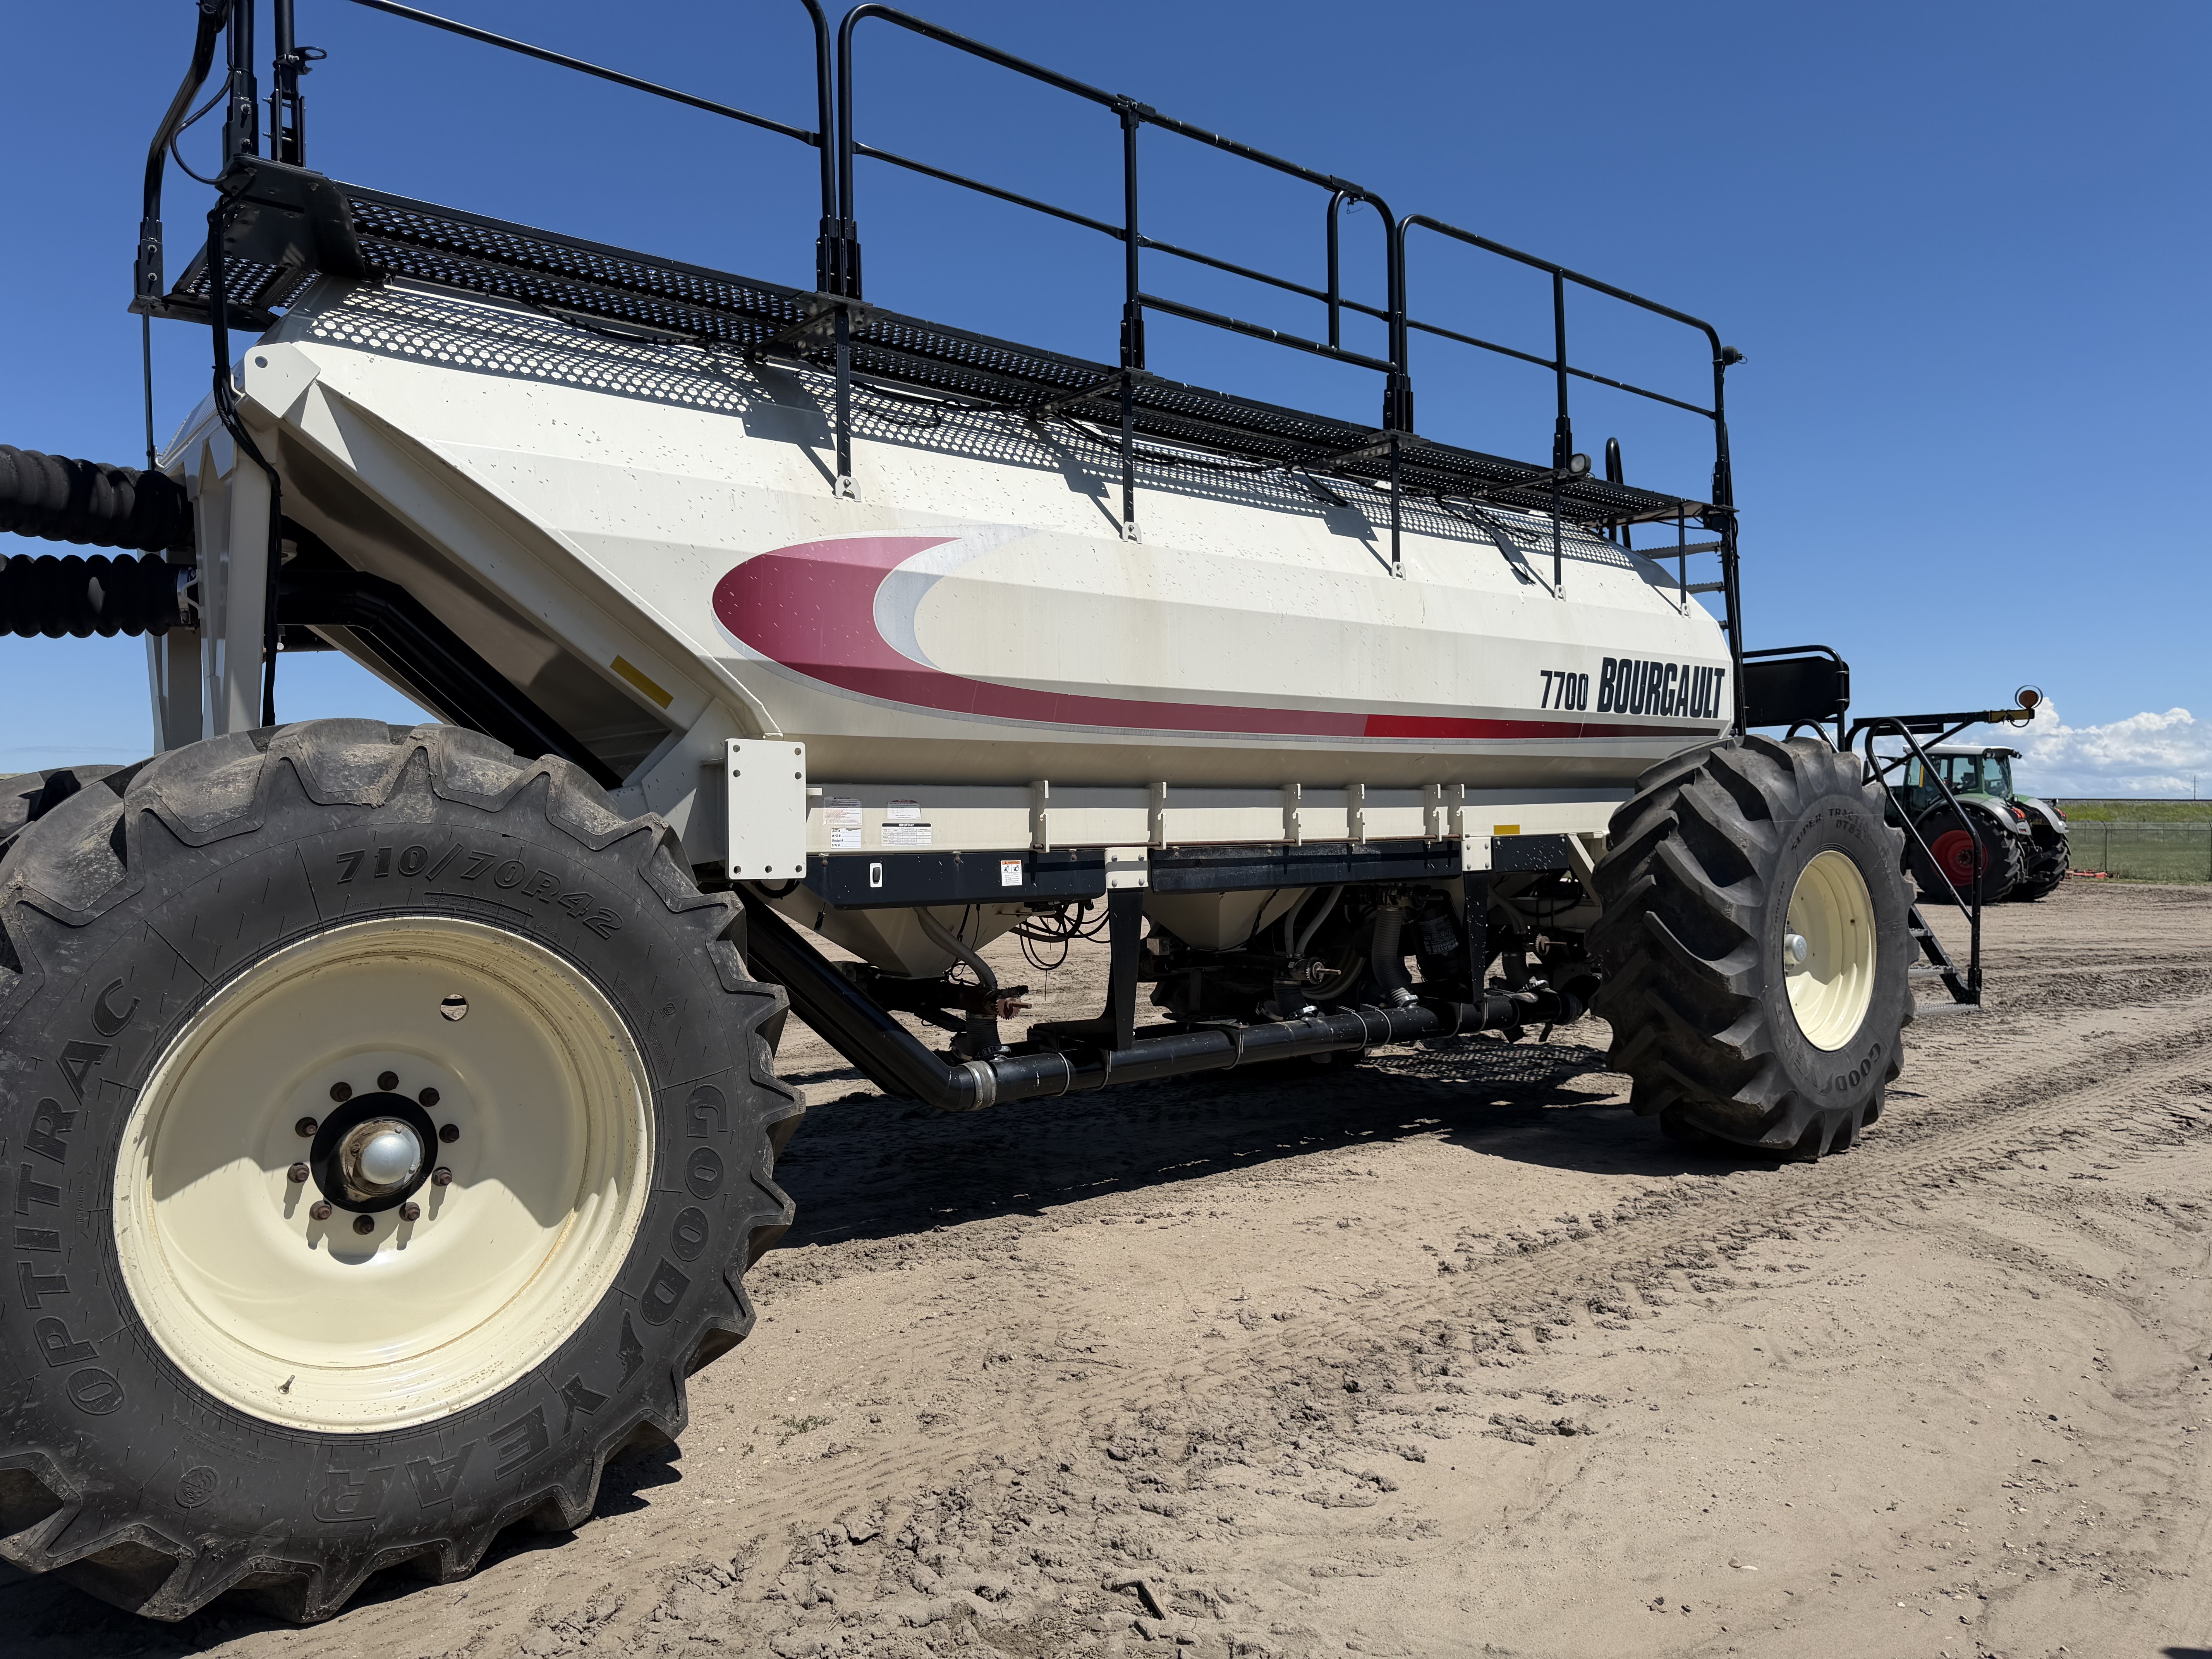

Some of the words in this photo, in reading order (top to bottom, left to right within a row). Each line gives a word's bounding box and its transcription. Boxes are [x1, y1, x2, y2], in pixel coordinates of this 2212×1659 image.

[1540, 670, 1589, 711] 7700
[1596, 657, 1726, 719] BOURGAULT
[1791, 812, 1822, 854] SUPER
[336, 842, 623, 941] 710/70R42
[13, 976, 141, 1416] OPTITRAC
[311, 1084, 728, 1523] GOODYEAR
[261, 1456, 282, 1465] MAY
